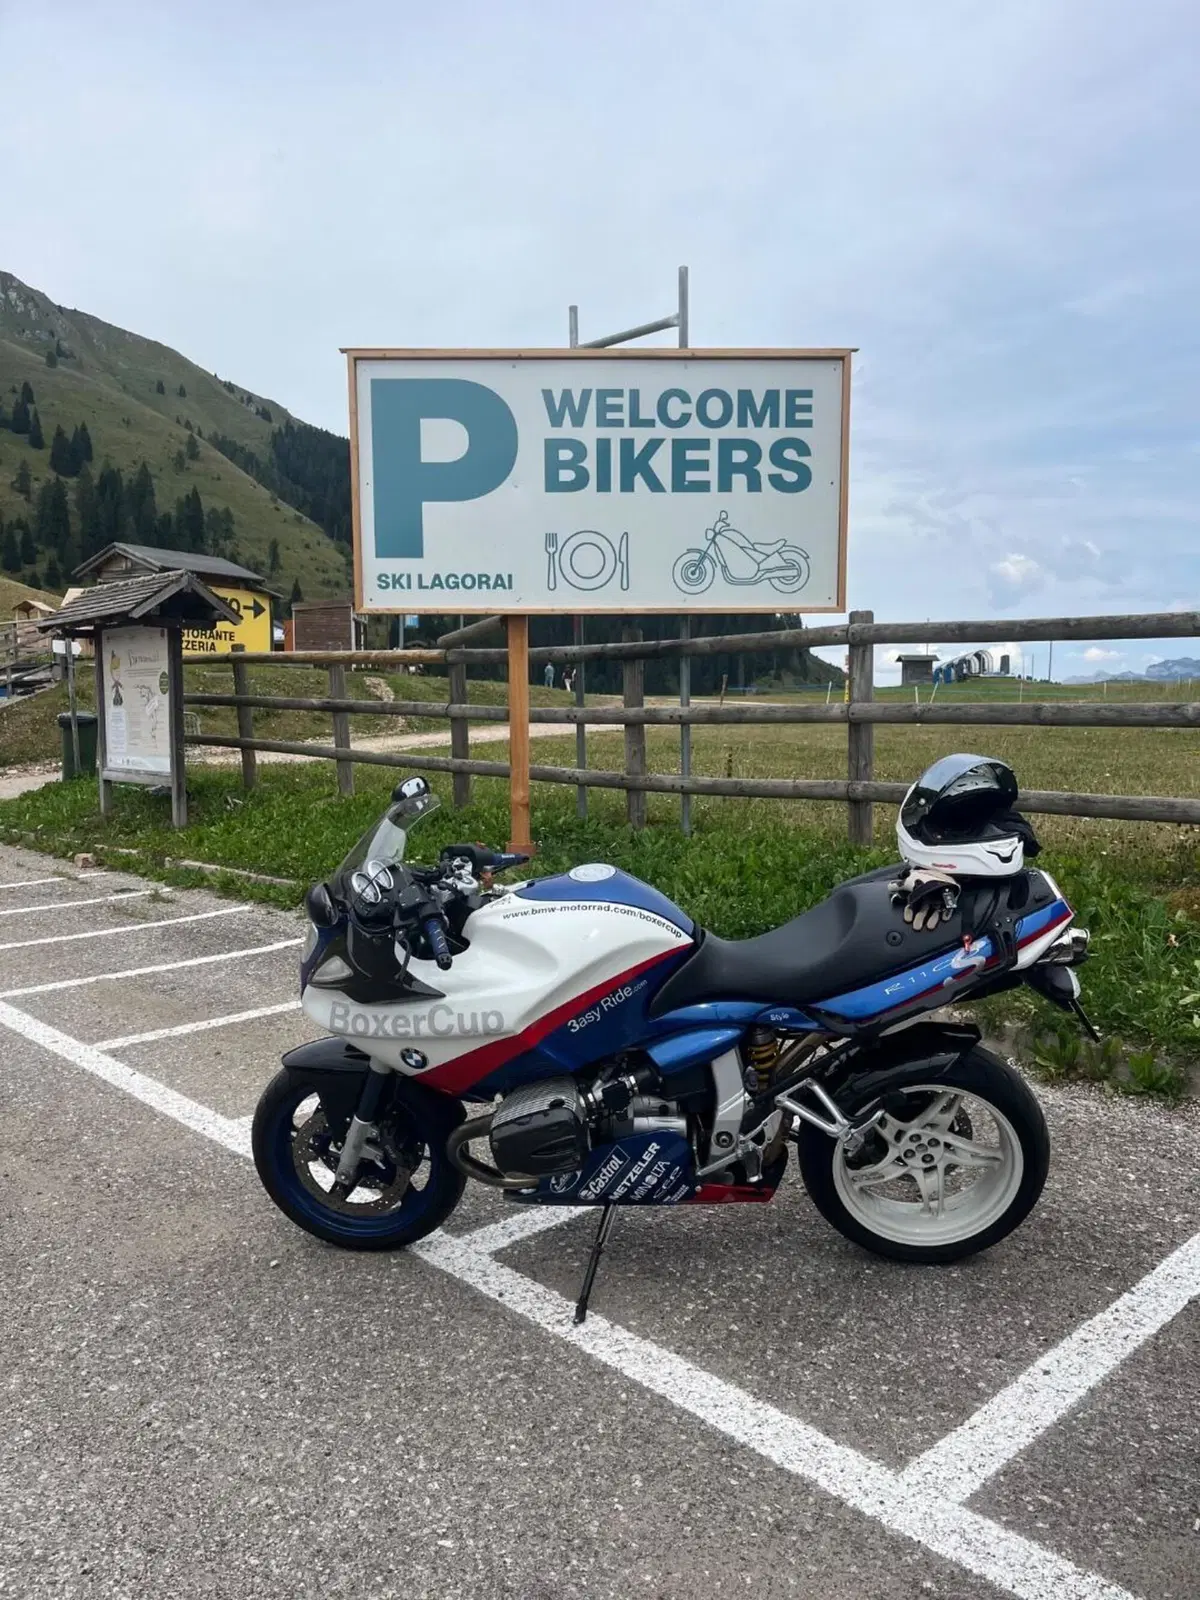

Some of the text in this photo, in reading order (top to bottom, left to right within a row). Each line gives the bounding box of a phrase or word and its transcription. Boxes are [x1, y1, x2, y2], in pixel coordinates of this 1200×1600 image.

[541, 388, 814, 428] WELCOME
[371, 378, 519, 559] P
[543, 436, 813, 494] BIKERS
[376, 572, 513, 590] SKI LAGORAI
[502, 901, 683, 939] www.bmw-motorrad.com/boxercup
[329, 1000, 505, 1037] BoxerCup
[588, 1154, 624, 1195] Castrol
[608, 1141, 661, 1201] METZELER
